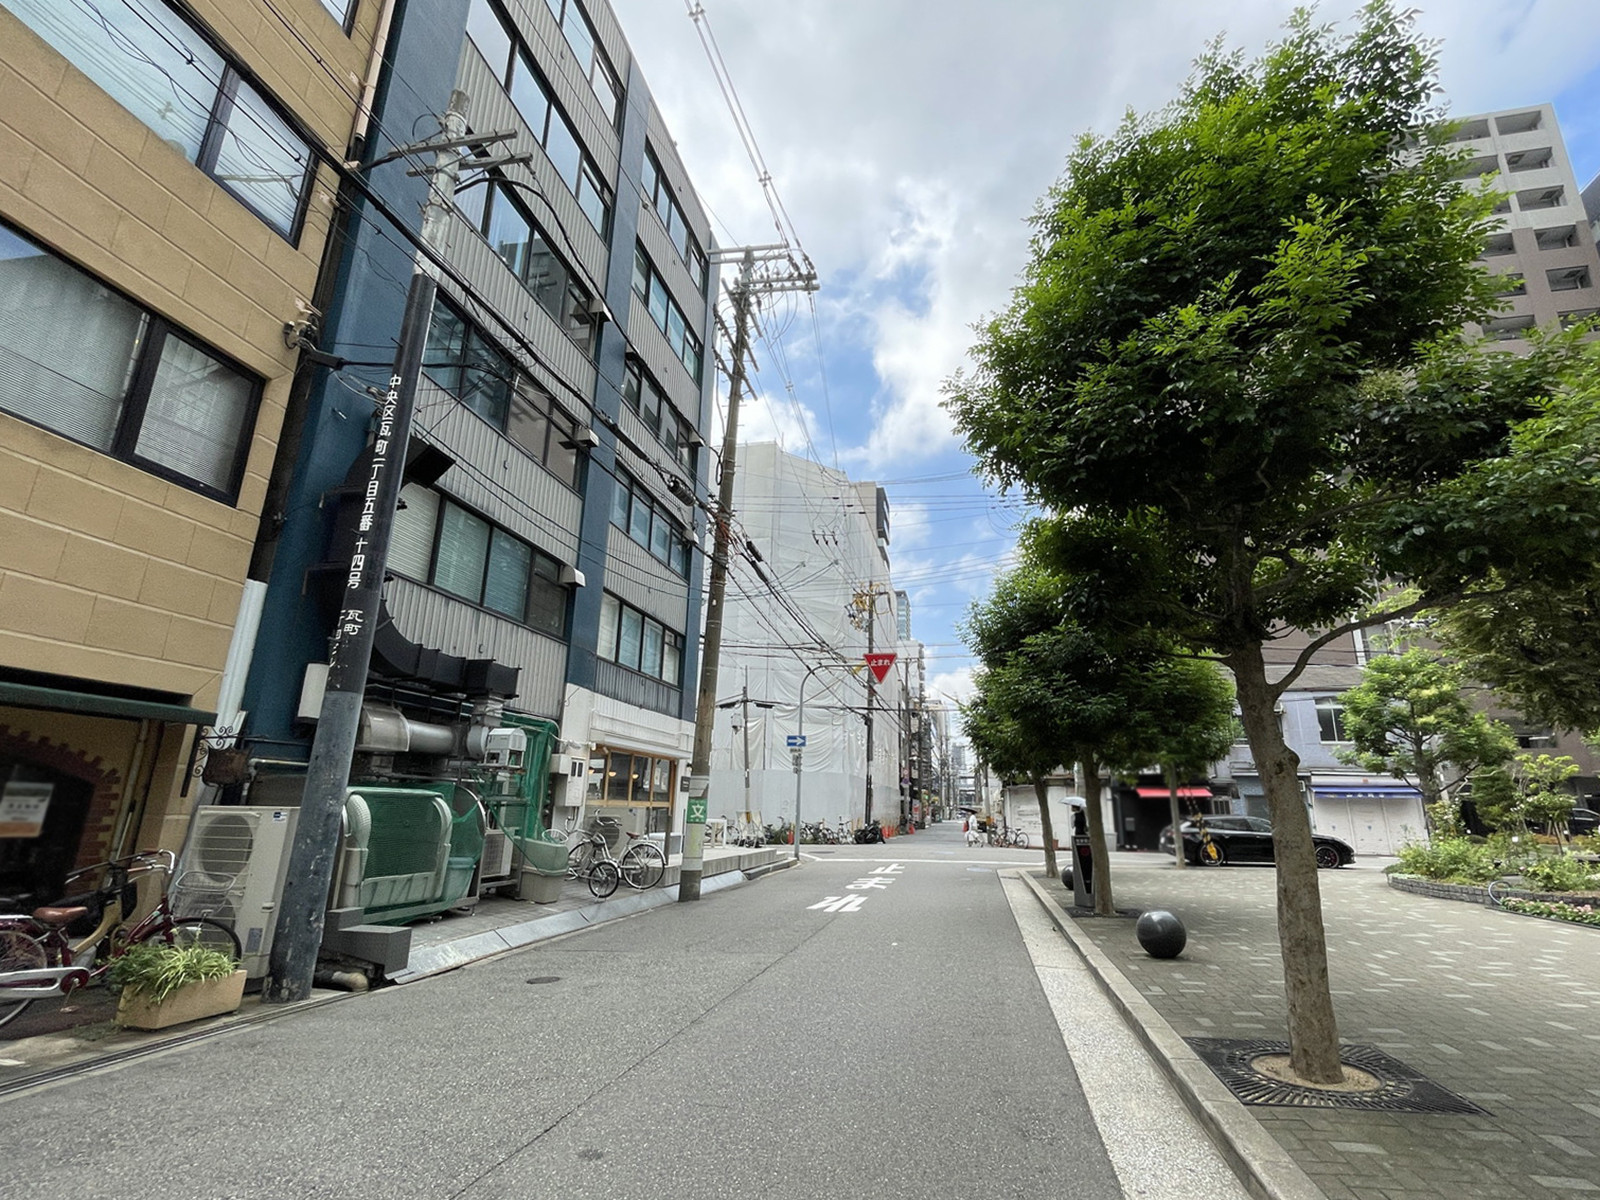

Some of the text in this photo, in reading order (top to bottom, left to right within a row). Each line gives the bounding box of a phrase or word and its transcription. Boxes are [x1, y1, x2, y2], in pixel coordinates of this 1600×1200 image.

[870, 658, 891, 667] 止まれ
[690, 803, 705, 818] 文
[806, 863, 905, 912] 止まれ
